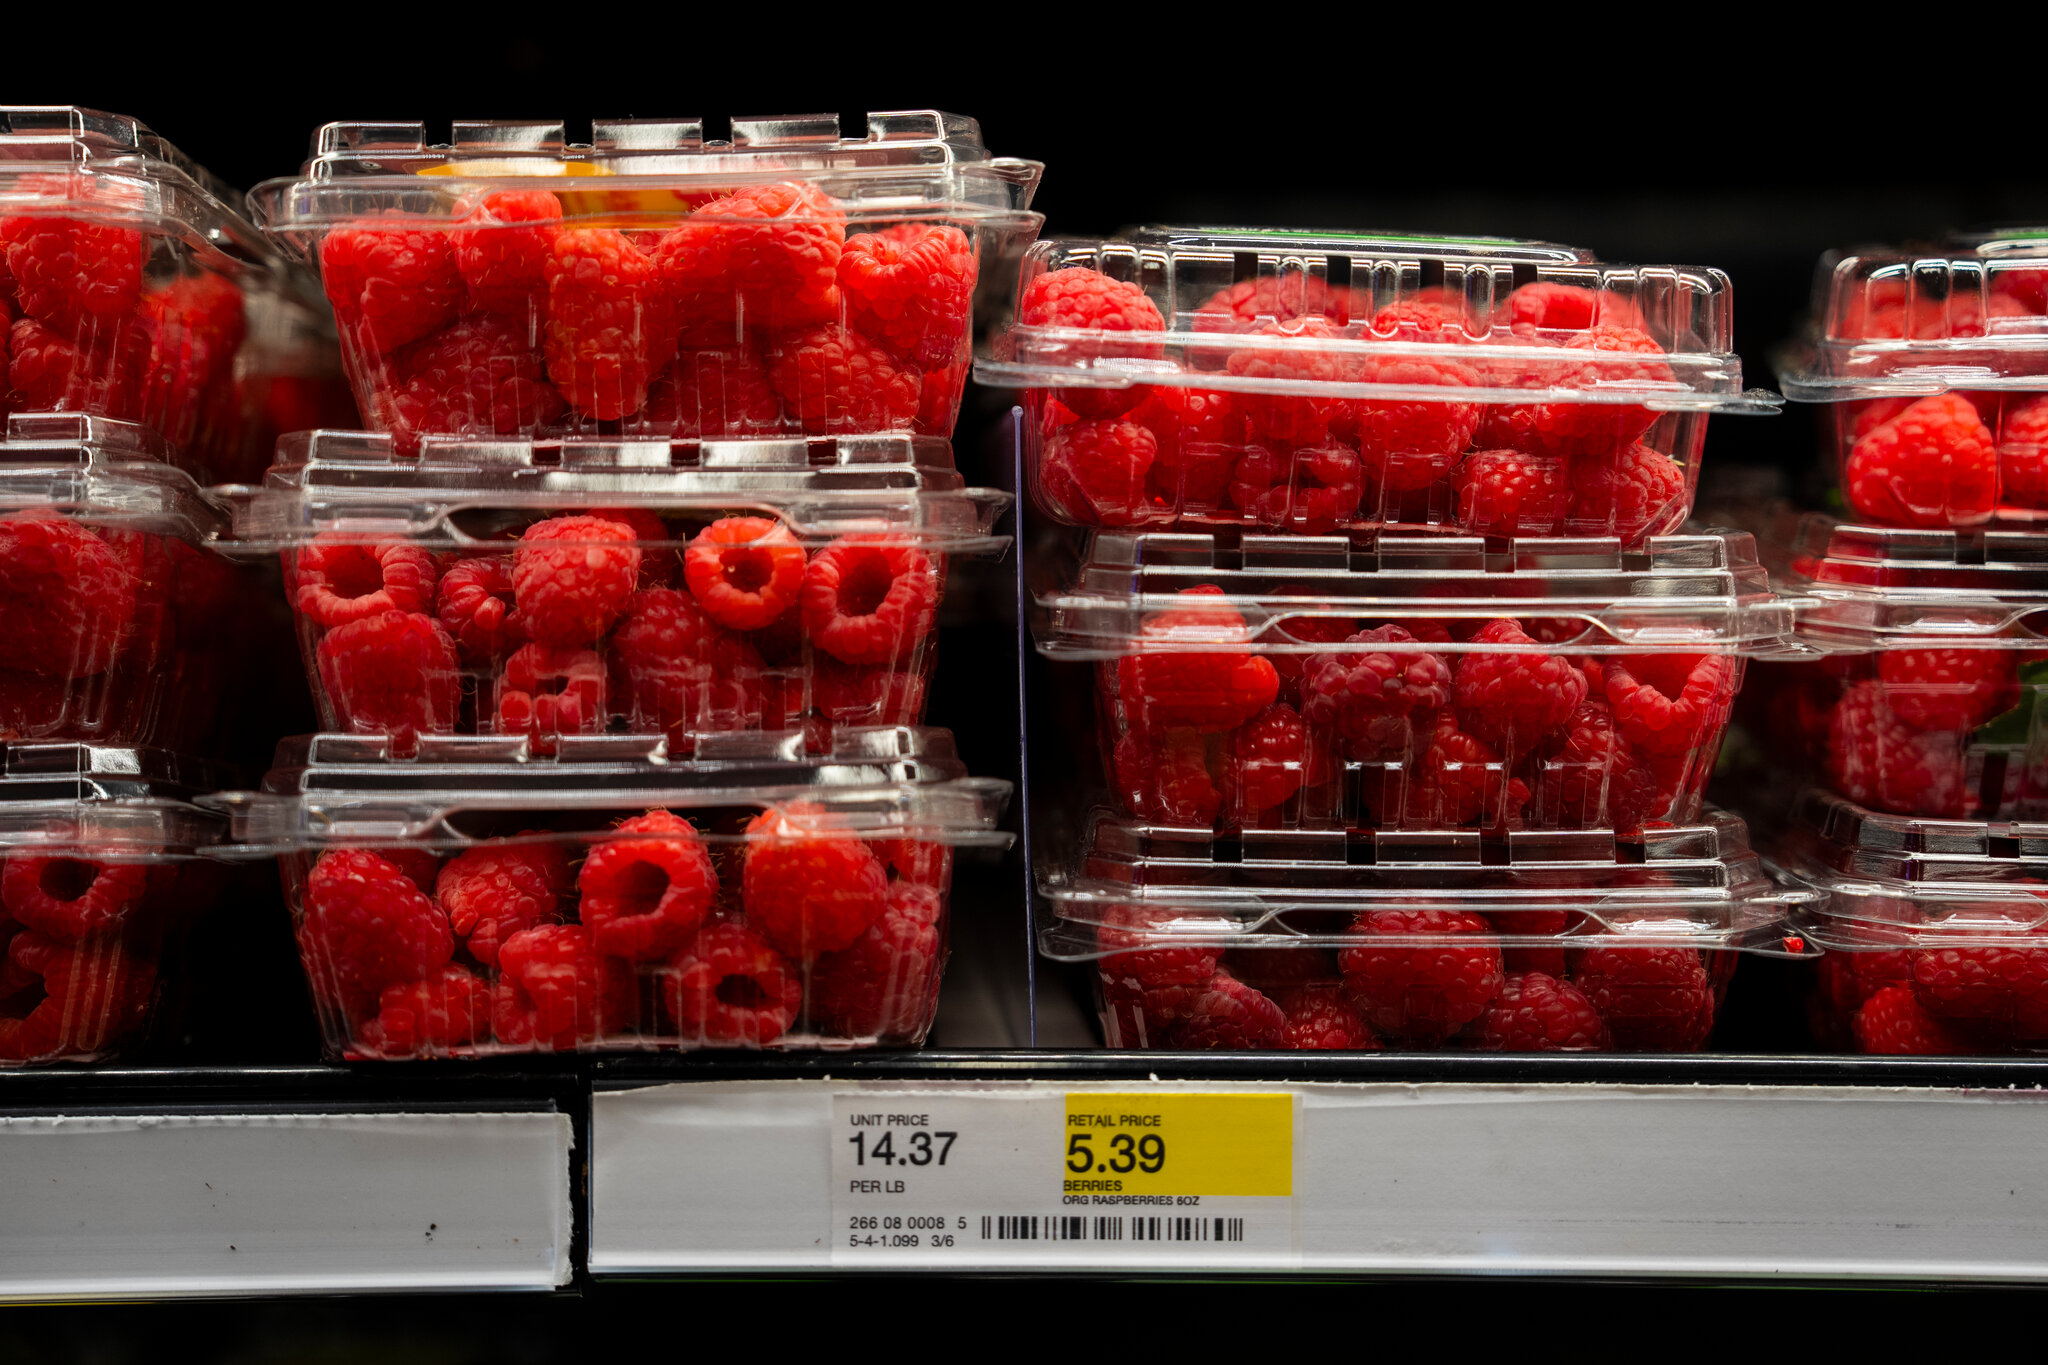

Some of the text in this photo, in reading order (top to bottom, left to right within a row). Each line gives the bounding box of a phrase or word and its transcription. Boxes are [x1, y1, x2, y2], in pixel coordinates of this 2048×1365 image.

[850, 1114, 929, 1127] UNIT PRICE
[1067, 1114, 1161, 1128] RETAIL PRICE
[849, 1131, 958, 1167] 14.37
[1066, 1133, 1166, 1174] 5.39
[850, 1179, 906, 1194] PER LB
[1062, 1179, 1123, 1192] BERRIES
[1062, 1194, 1200, 1206] ORG RASPBERRIES 6OZ
[849, 1216, 967, 1230] 266 08 0008 5
[849, 1234, 955, 1248] 5-4-1.099 3/6
